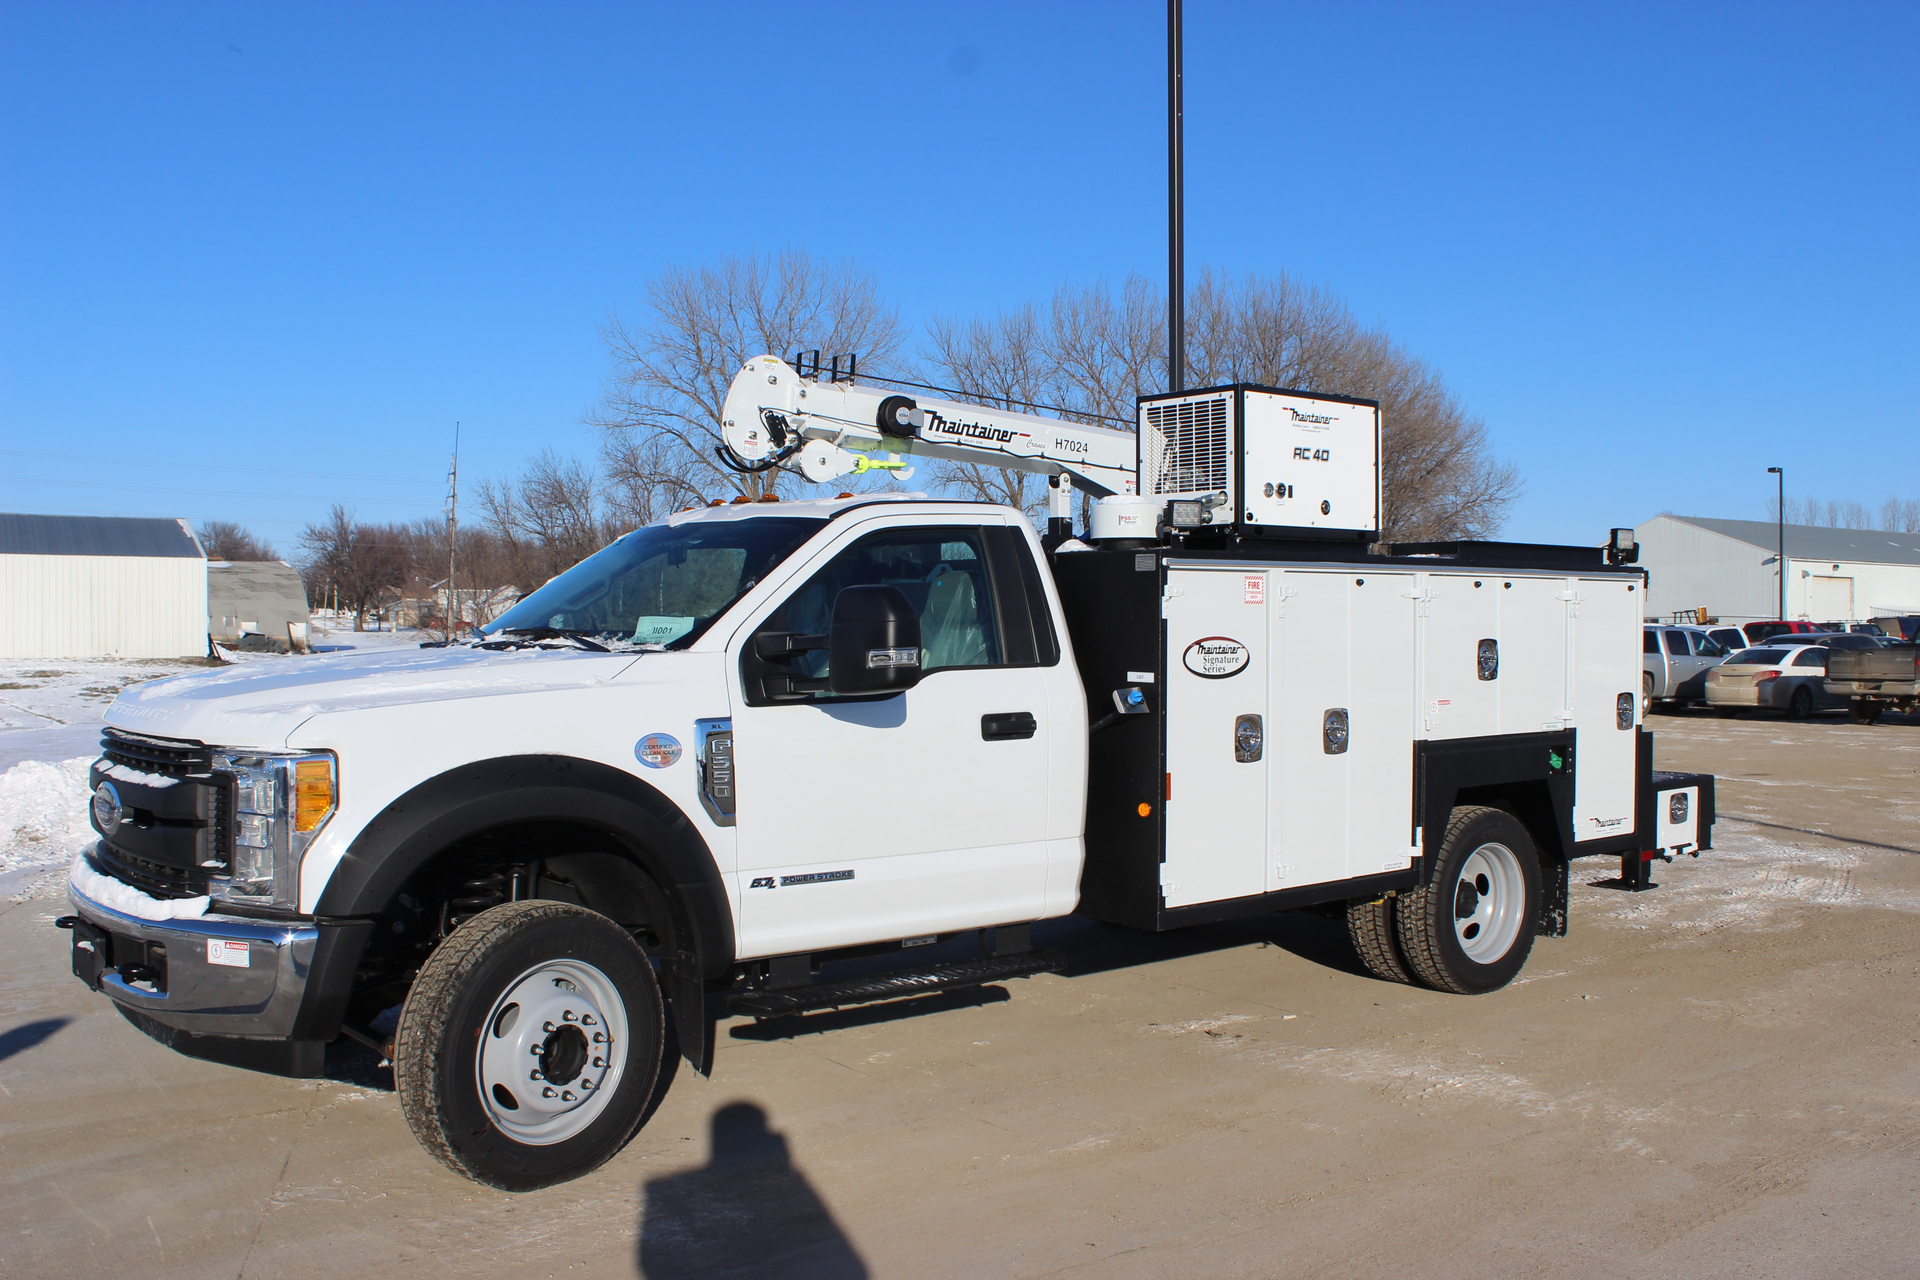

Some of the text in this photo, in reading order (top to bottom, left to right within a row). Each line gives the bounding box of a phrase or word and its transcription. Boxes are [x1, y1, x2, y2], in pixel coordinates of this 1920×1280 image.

[1289, 408, 1333, 424] Maintainer
[923, 409, 1019, 443] Maintainer
[1025, 438, 1088, 453] Cranes H7024
[1293, 447, 1330, 462] AC 40
[1247, 581, 1260, 590] FIRE
[1195, 642, 1241, 655] Maintainer
[1203, 655, 1240, 666] Signature
[1203, 665, 1226, 673] Series
[750, 877, 776, 889] 6.7L
[783, 871, 854, 883] POWER STROKE
